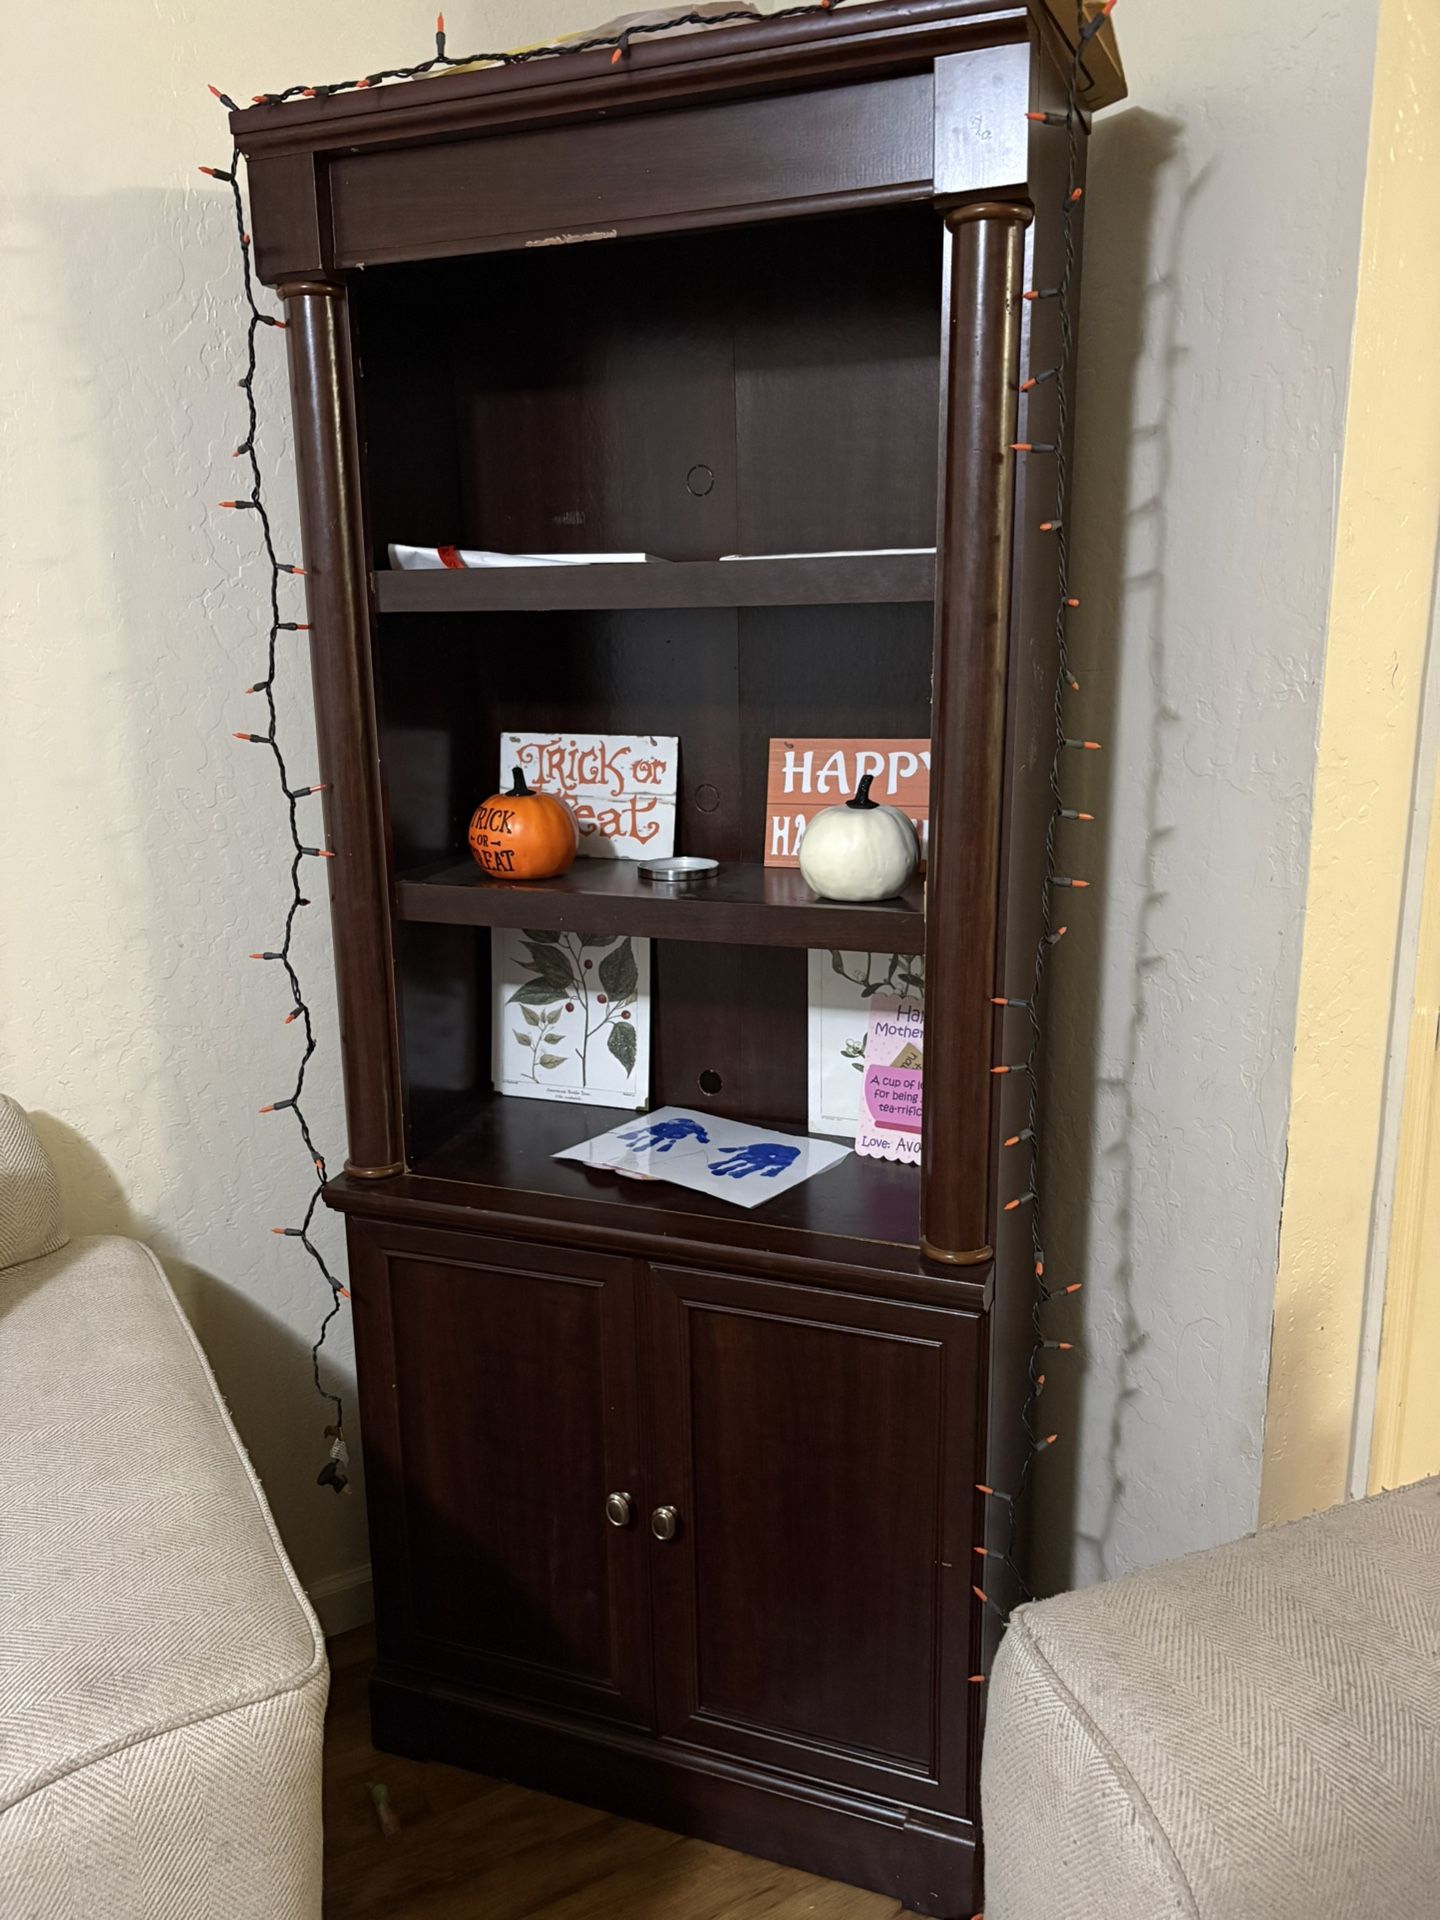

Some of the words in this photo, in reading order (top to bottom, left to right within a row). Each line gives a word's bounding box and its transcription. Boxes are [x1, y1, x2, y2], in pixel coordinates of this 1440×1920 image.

[630, 757, 667, 785] or
[549, 788, 660, 845] eat
[476, 834, 489, 848] OR
[870, 1074, 880, 1086] A
[882, 1077, 902, 1089] cup
[903, 1079, 916, 1090] of
[874, 1088, 890, 1099] for
[892, 1091, 919, 1104] being
[861, 1135, 891, 1149] Love:
